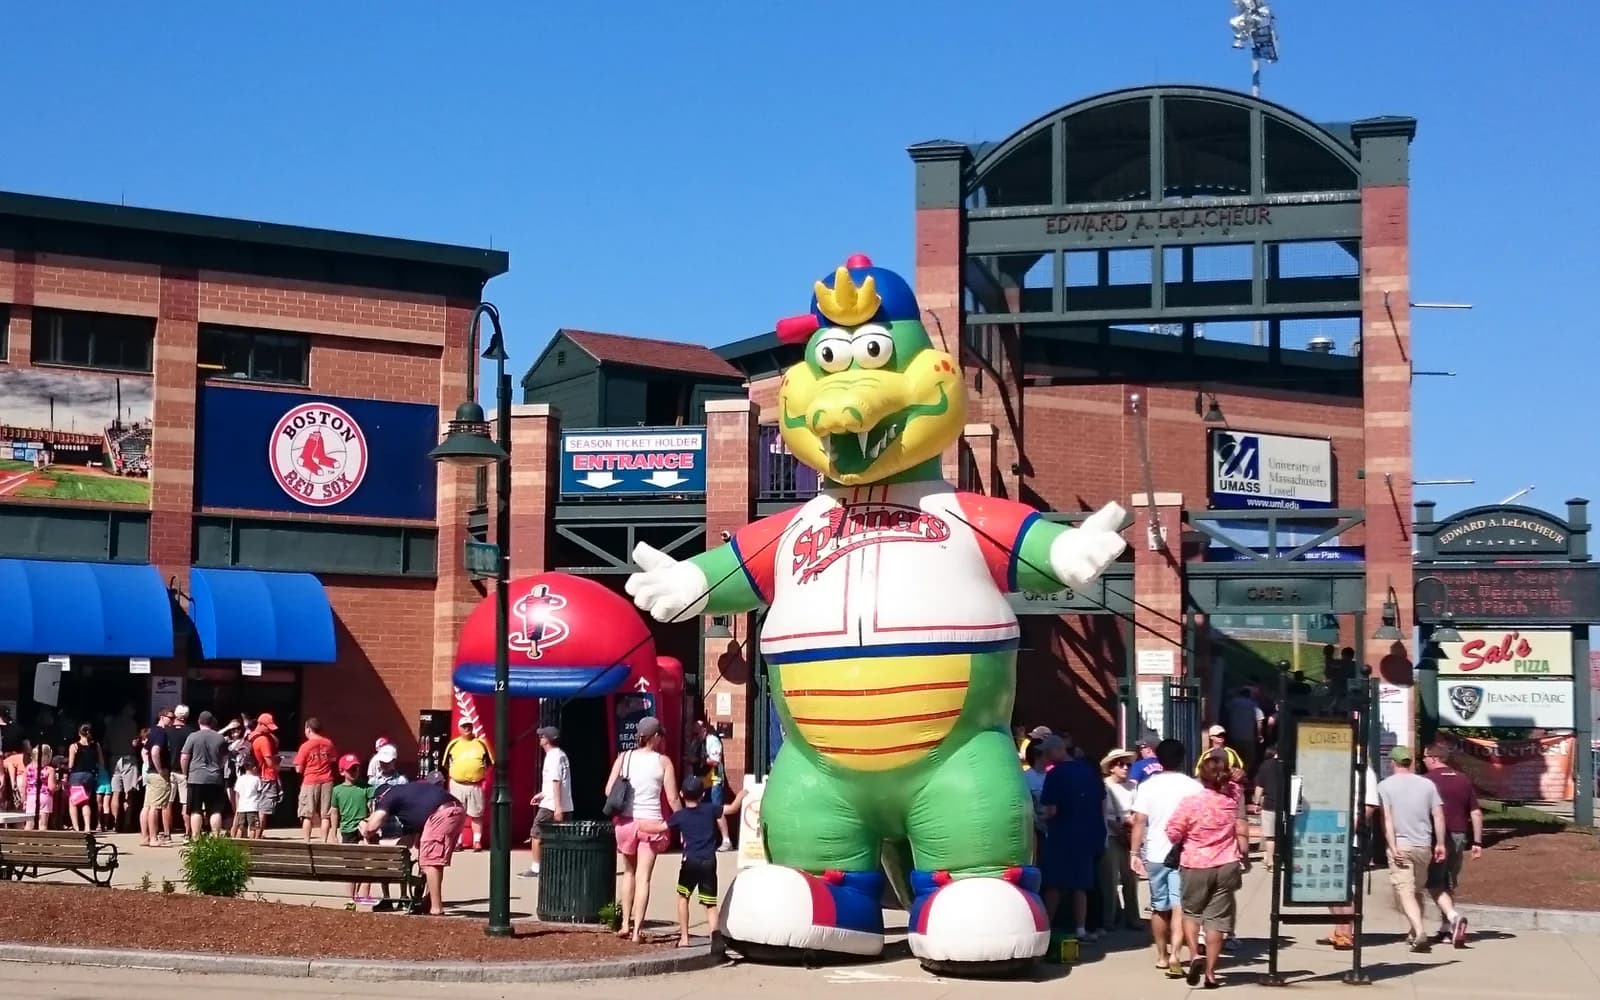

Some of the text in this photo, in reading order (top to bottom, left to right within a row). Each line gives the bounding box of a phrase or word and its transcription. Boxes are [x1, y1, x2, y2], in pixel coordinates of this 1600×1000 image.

[1046, 214, 1127, 234] EDWARD
[1136, 215, 1153, 230] A.
[1159, 207, 1273, 229] LeLACHEUR
[282, 411, 356, 443] BOSTON
[570, 437, 698, 449] SEASON TICKET HOLDER
[573, 453, 694, 470] ENTRANCE
[1268, 457, 1321, 475] University of
[283, 470, 352, 498] RED SOX
[1219, 480, 1261, 494] UMASS
[1269, 472, 1328, 488] Massachusetts
[1269, 485, 1296, 497] Lowell
[1247, 498, 1300, 510] www.uml.edu
[792, 499, 949, 577] Spinners
[1439, 518, 1565, 545] EDWARD A. LeLACHEUR
[1321, 551, 1340, 559] Park
[1248, 586, 1284, 601] GATE
[1459, 631, 1532, 672] Sal's
[1514, 660, 1550, 672] PIZZA
[494, 680, 505, 692] 12
[1487, 693, 1566, 703] JEANNE D'ARC
[1309, 732, 1353, 744] LOWELL
